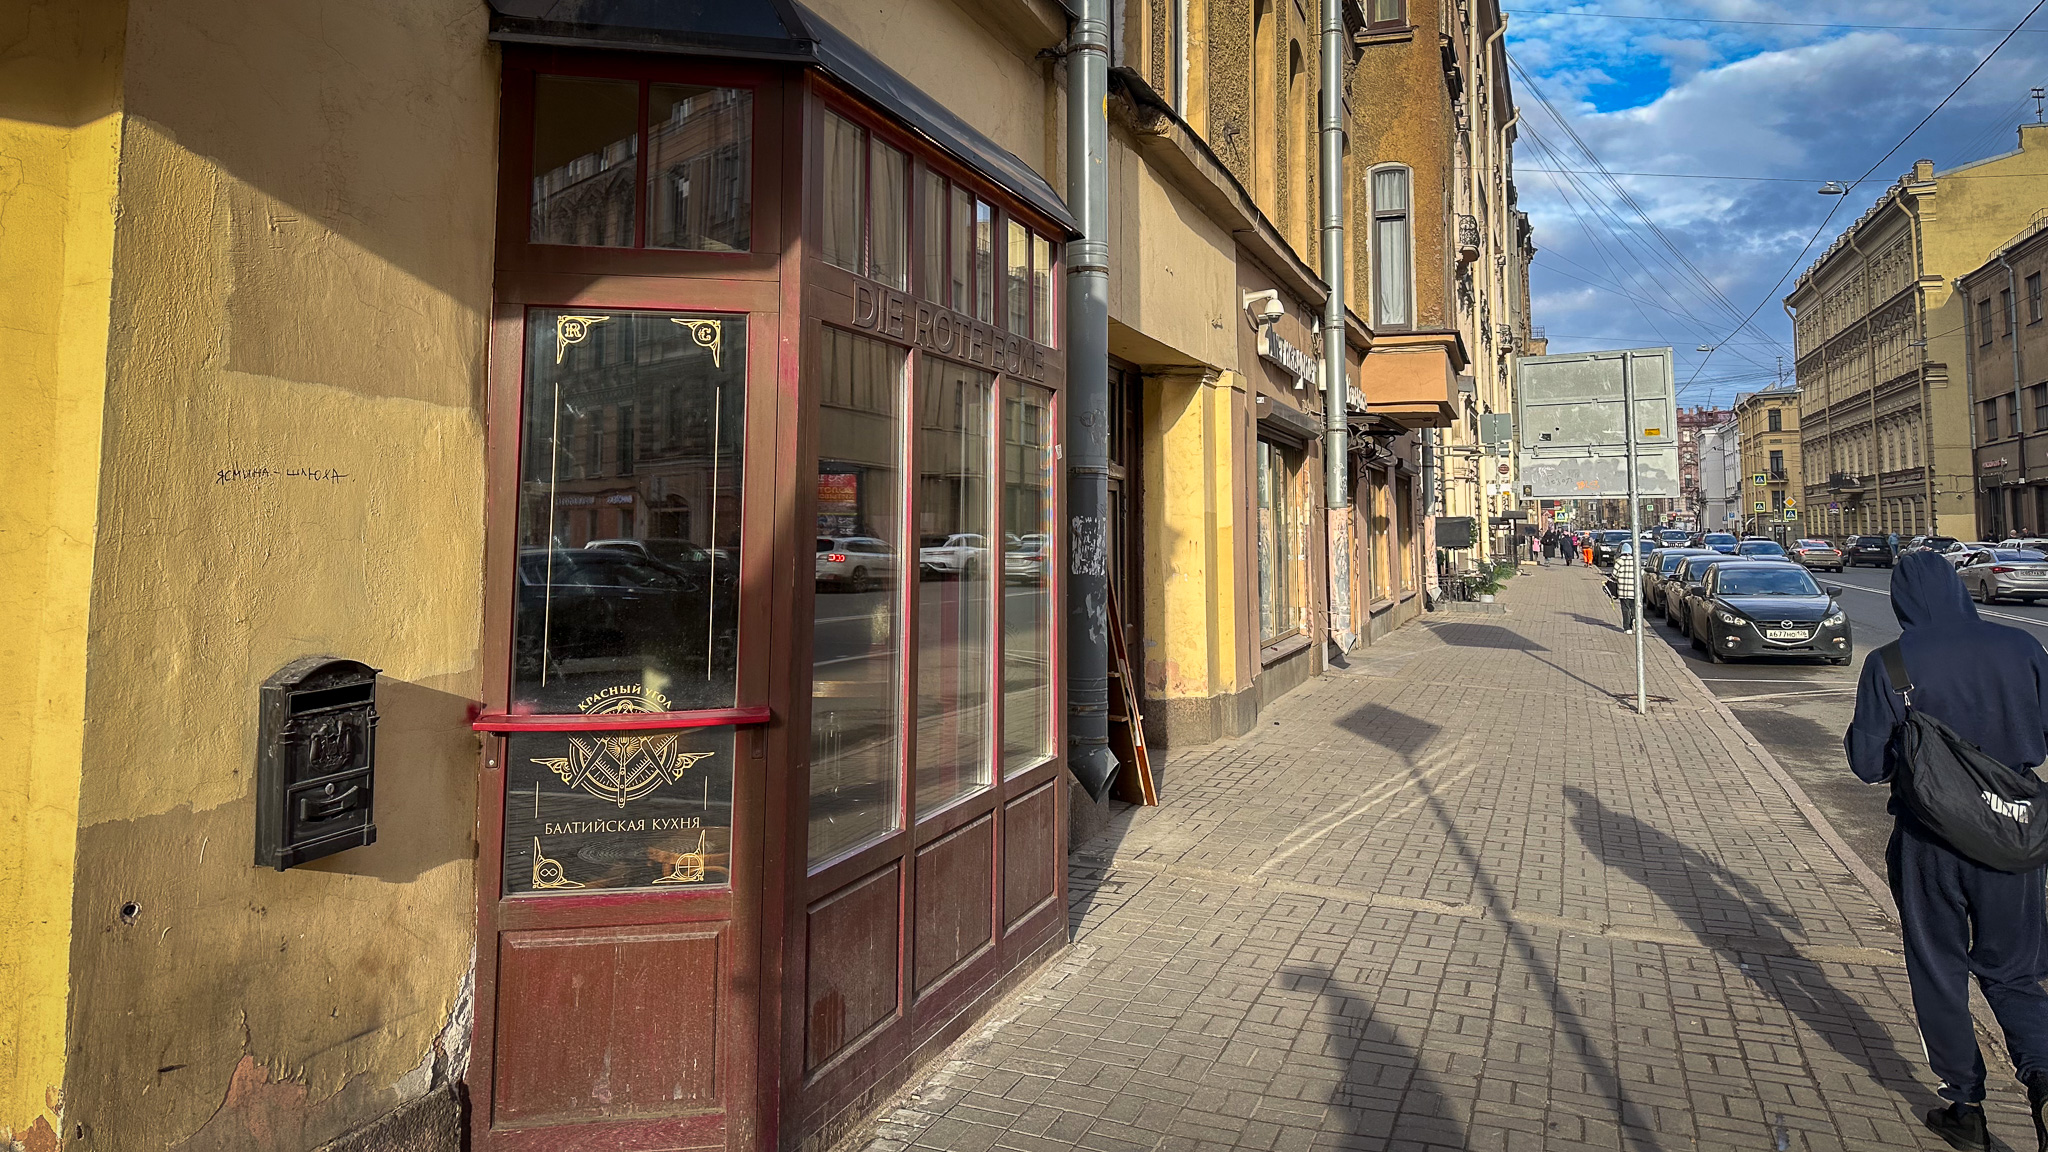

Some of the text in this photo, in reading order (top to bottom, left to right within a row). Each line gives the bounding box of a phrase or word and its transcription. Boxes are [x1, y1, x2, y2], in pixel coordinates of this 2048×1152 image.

[852, 277, 1045, 382] DIE ROTE ECKE
[577, 683, 673, 711] КРАСНЫЙ УГОЛ
[544, 816, 701, 835] БАЛТИЙСКАЯ КУХНЯ
